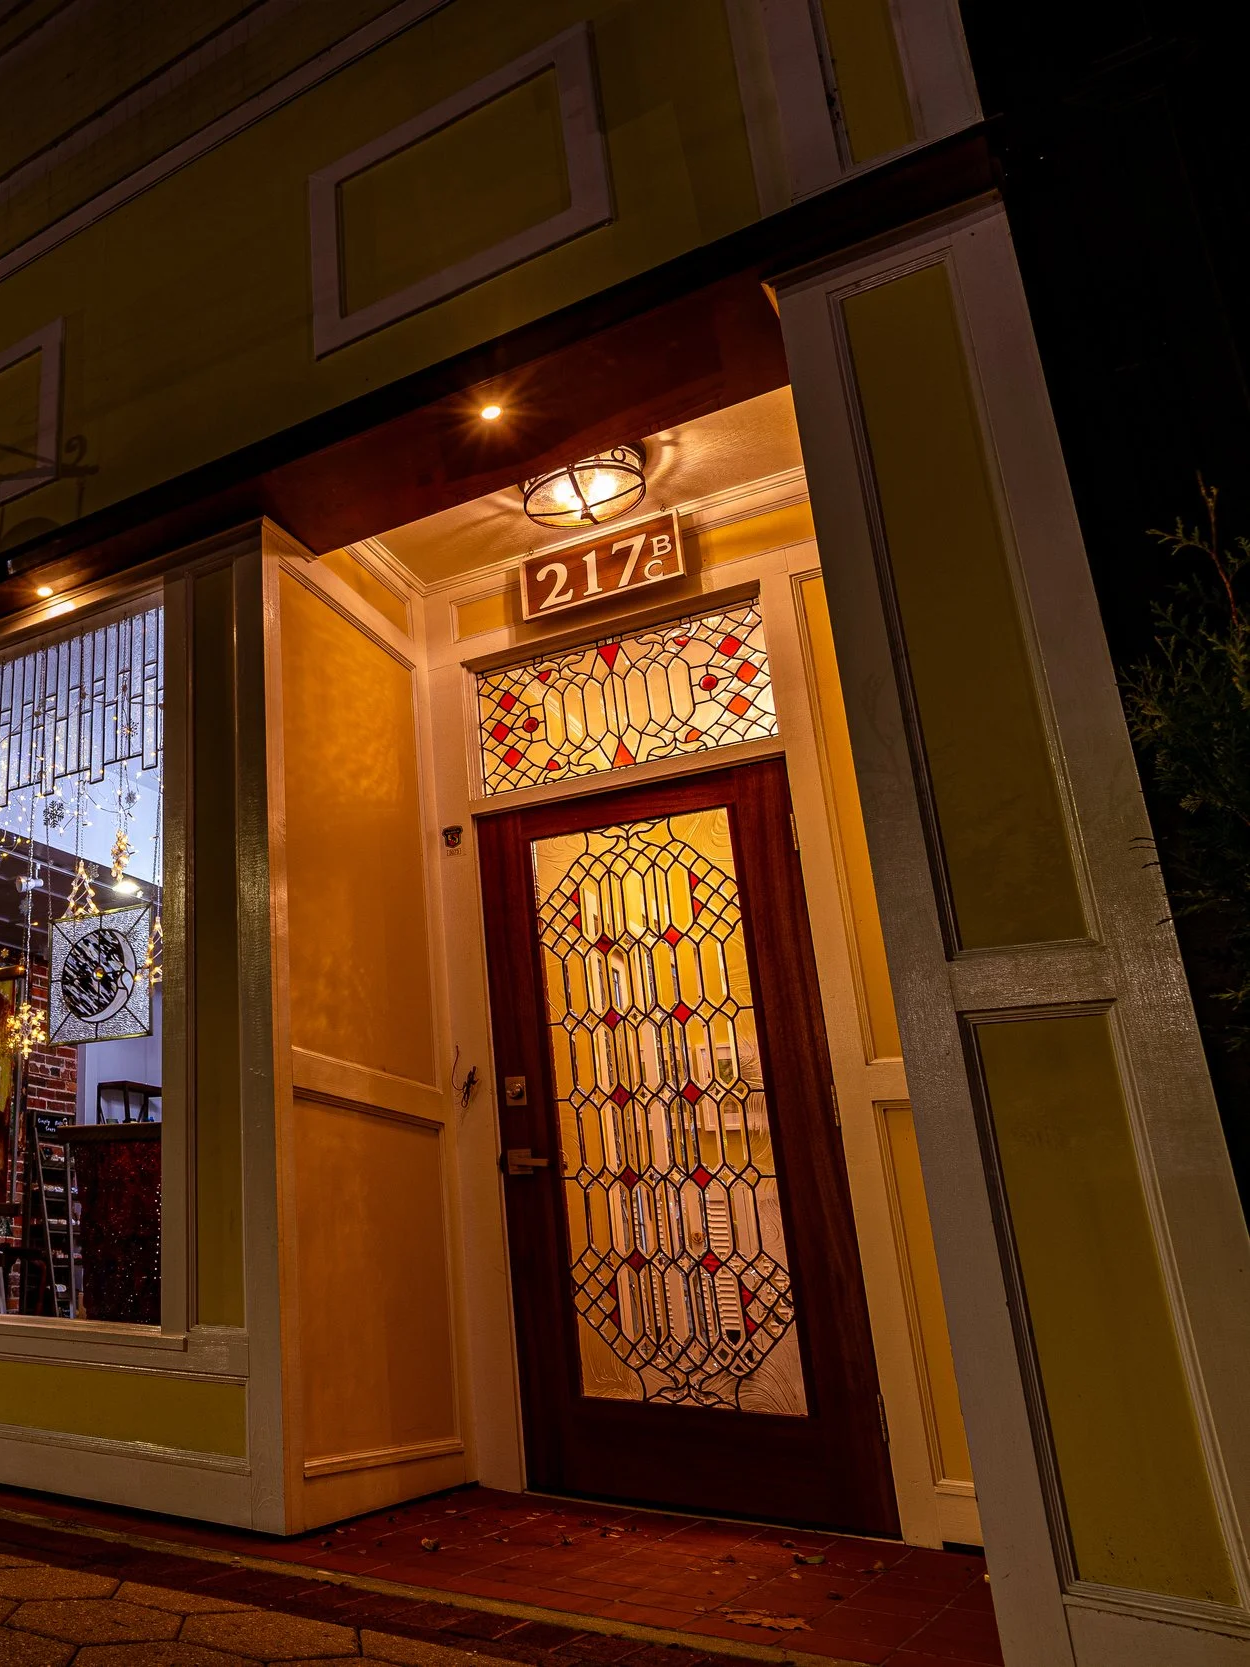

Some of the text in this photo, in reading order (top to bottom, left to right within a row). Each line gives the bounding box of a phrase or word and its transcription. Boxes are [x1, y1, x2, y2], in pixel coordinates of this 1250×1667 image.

[536, 533, 672, 610] 217 B
[643, 559, 664, 581] C
